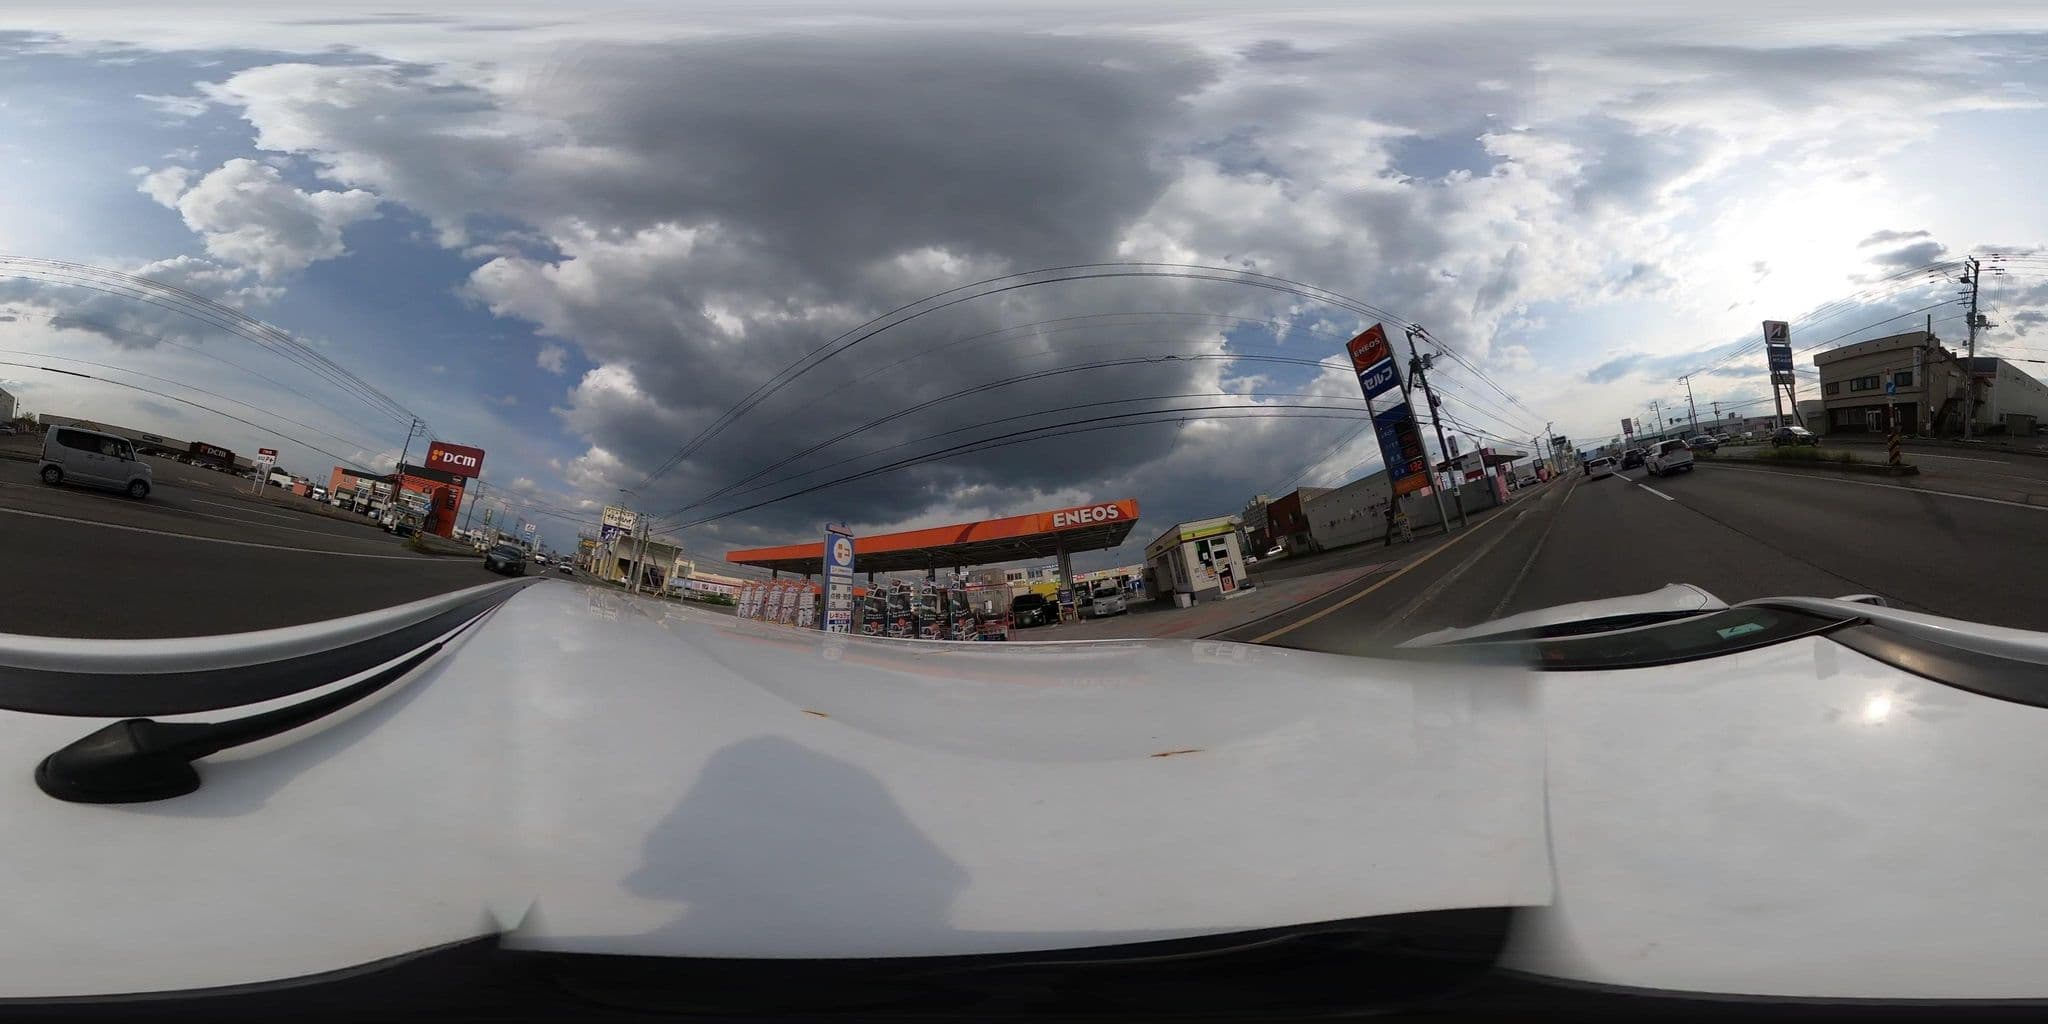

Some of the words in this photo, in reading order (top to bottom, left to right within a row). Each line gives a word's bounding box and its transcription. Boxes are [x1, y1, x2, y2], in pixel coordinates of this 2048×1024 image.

[1353, 337, 1381, 357] ENEOS
[1364, 366, 1393, 390] セルフ
[1053, 504, 1119, 528] ENEOS
